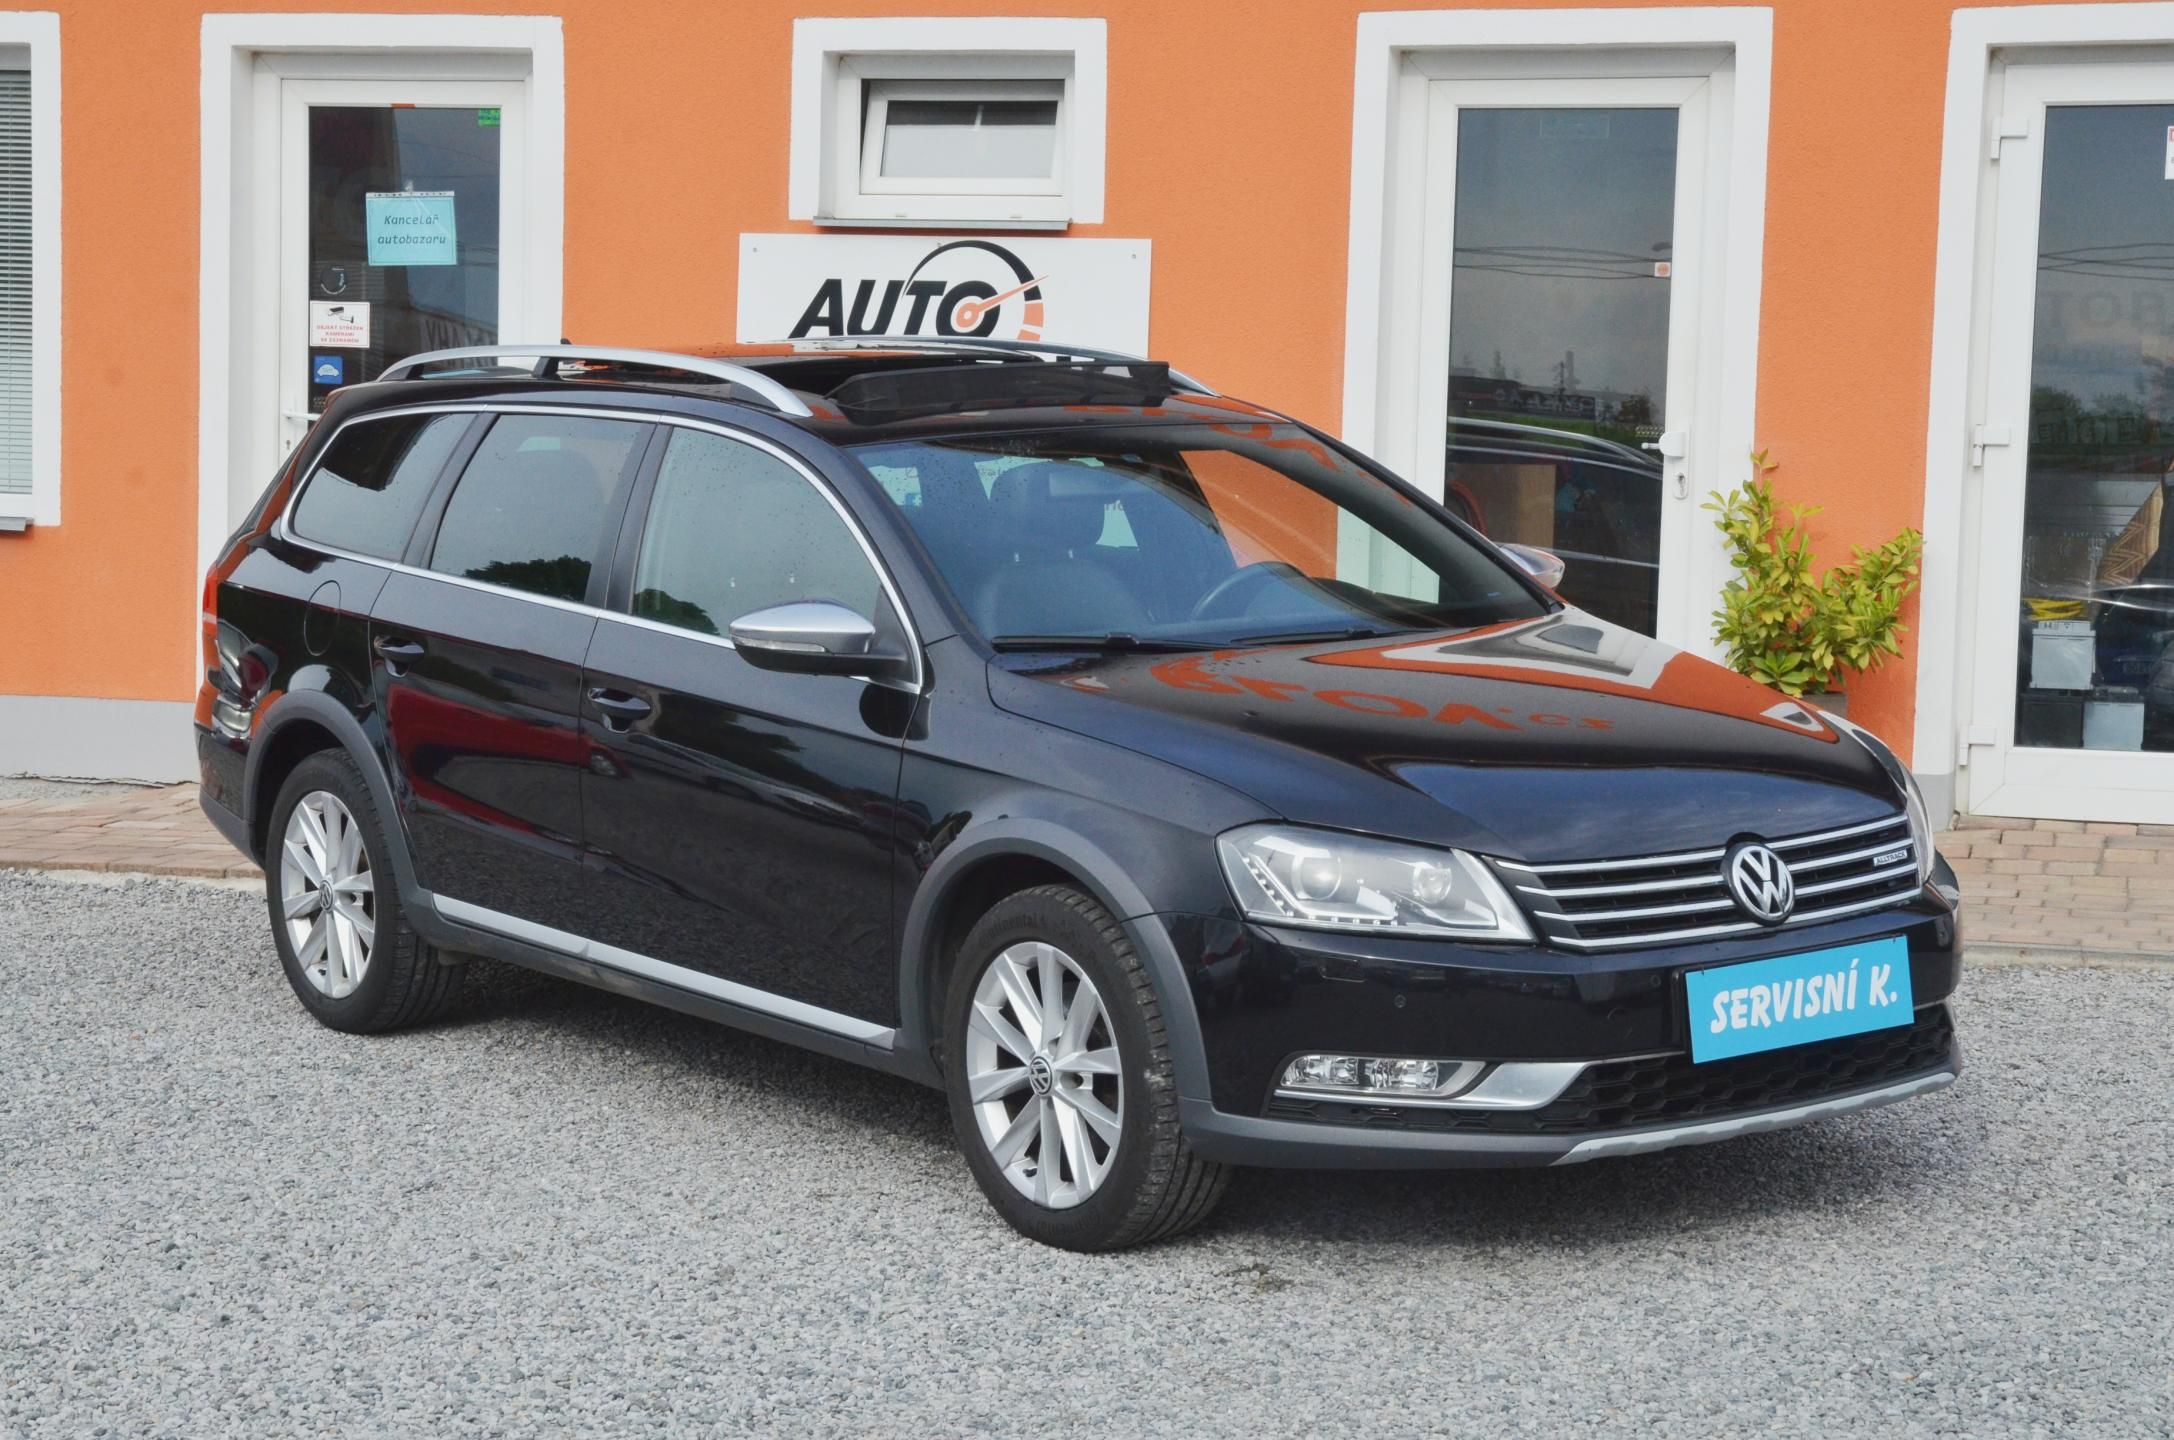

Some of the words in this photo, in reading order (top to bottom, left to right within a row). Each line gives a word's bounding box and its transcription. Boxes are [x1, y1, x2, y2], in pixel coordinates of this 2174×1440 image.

[383, 213, 439, 225] Kancelář
[377, 233, 446, 245] autobazaru
[788, 278, 1001, 338] AUTO
[1876, 850, 1906, 864] ALLTRACK
[1710, 958, 1860, 1034] SERVISNÍ
[1869, 963, 1898, 1007] K.
